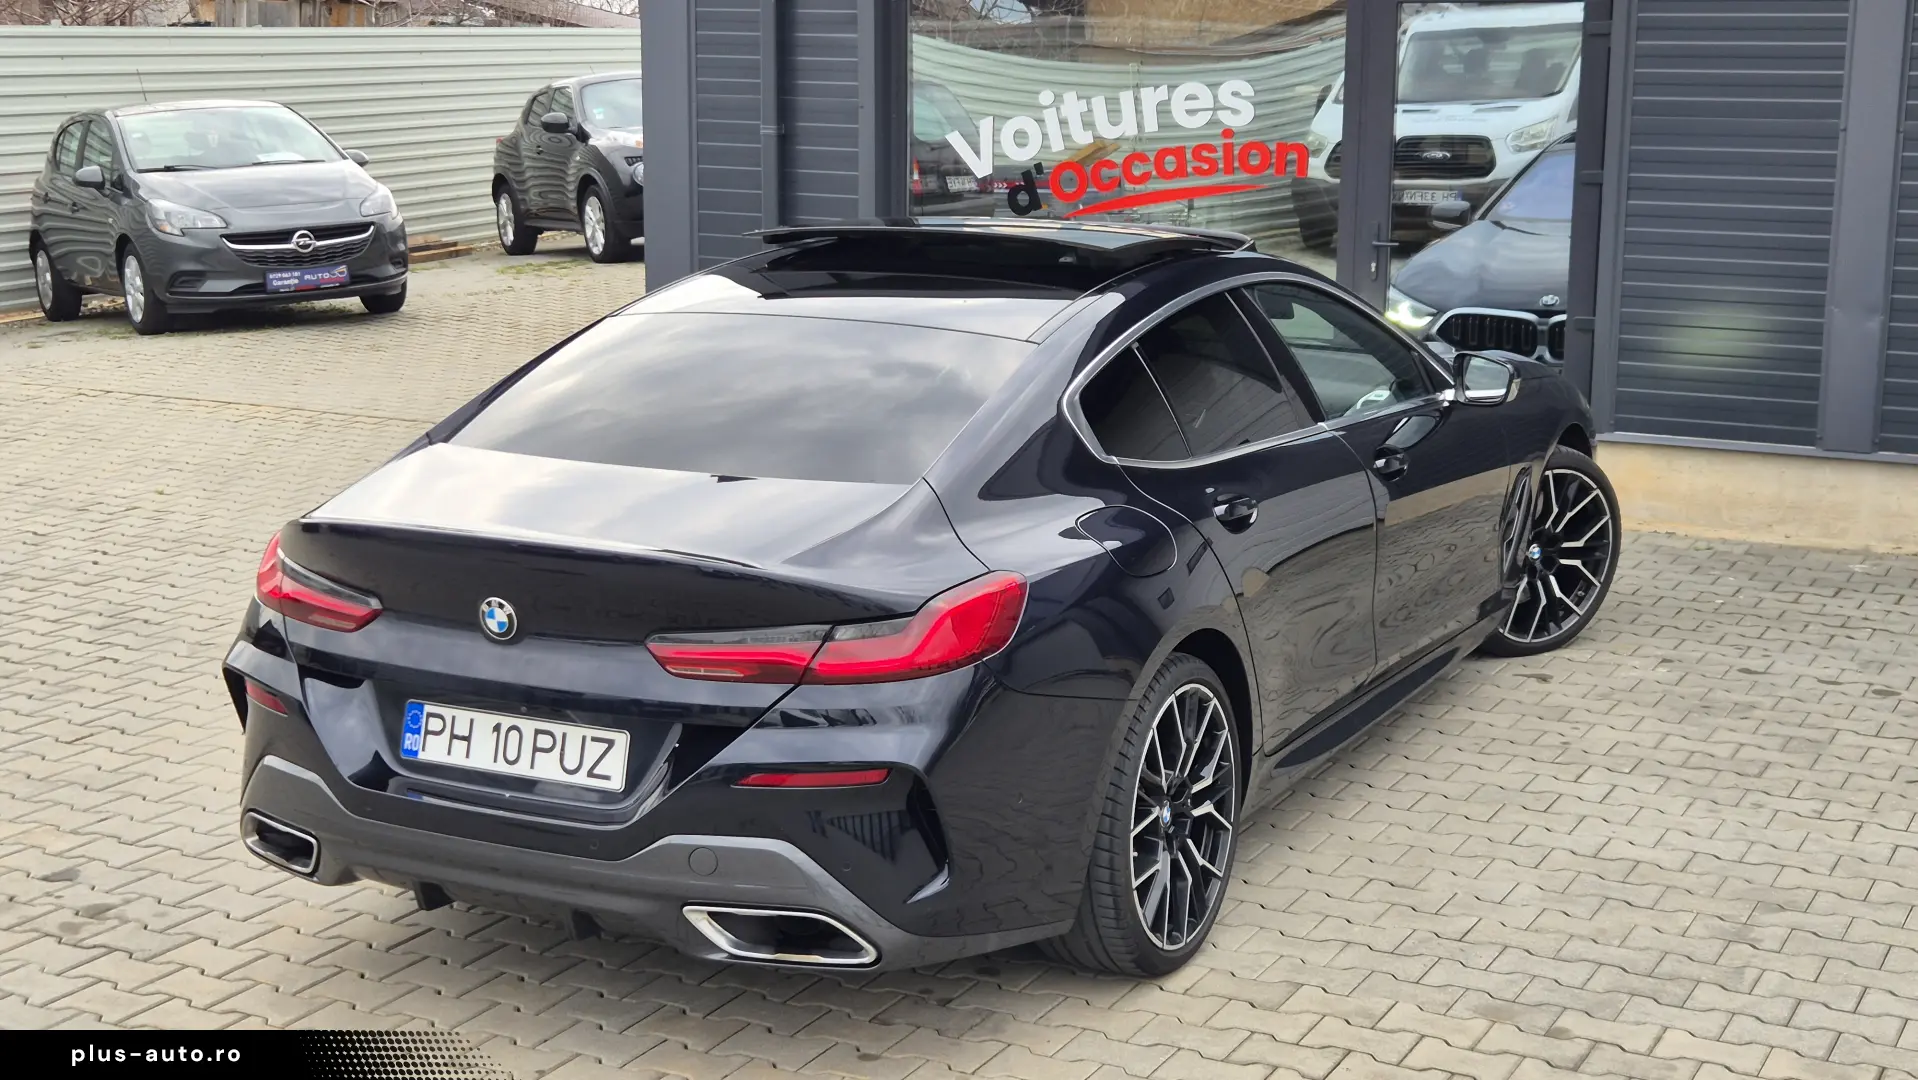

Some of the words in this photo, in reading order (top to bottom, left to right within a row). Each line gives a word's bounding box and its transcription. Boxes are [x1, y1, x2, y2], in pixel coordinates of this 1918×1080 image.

[945, 79, 1256, 180] Voitures
[403, 733, 420, 751] RO
[421, 711, 475, 759] PH
